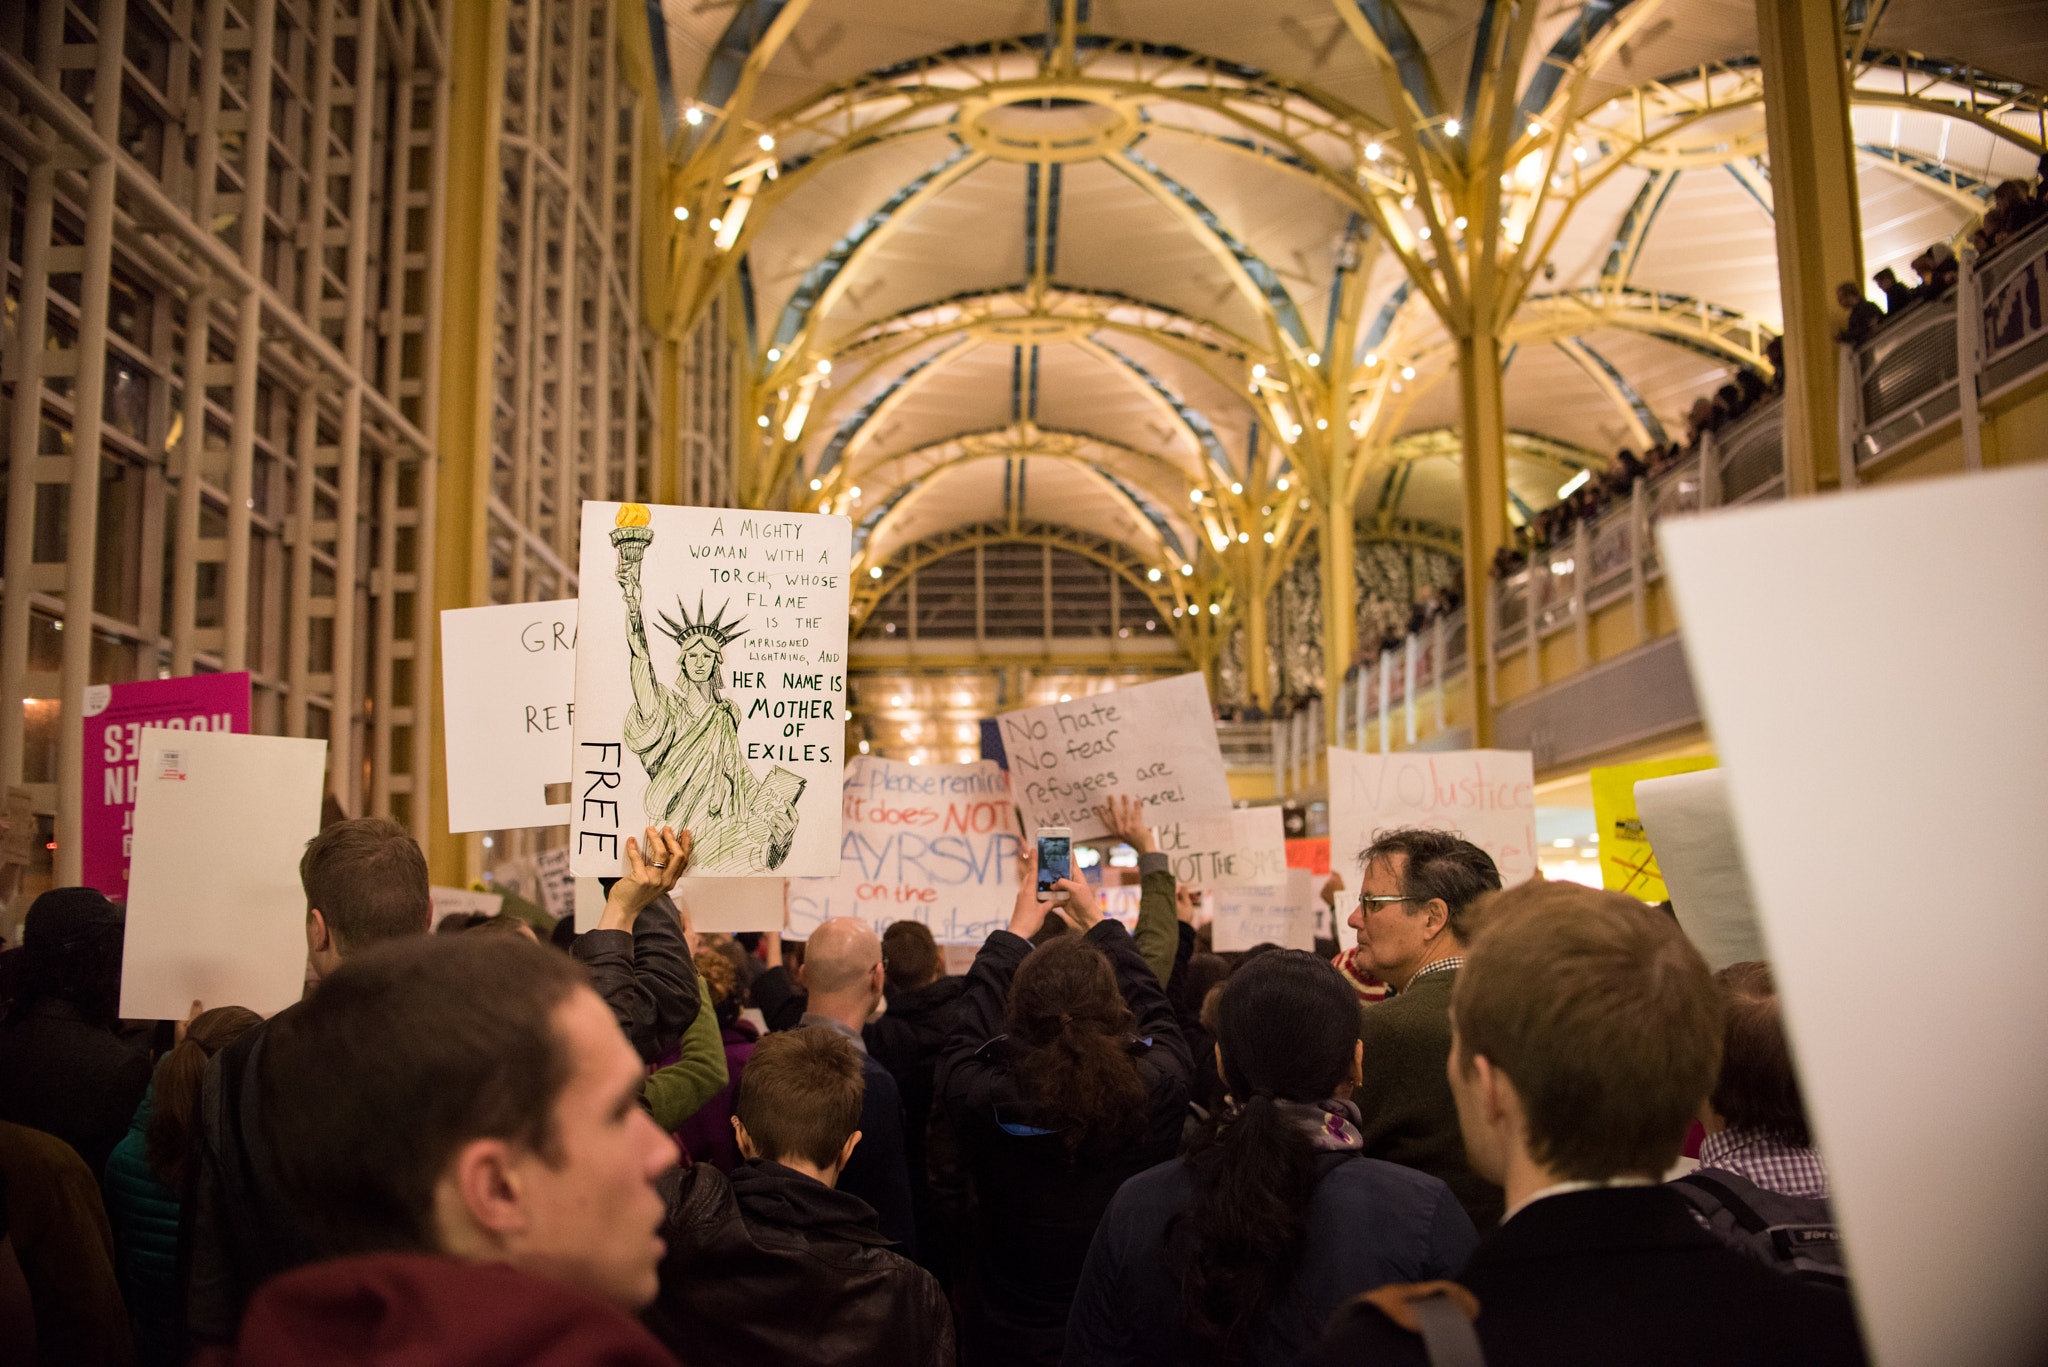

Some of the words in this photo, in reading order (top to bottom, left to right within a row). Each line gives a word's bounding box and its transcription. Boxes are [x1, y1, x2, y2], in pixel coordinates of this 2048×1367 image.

[711, 516, 724, 537] A
[740, 518, 803, 540] MIGHTY
[689, 545, 747, 560] WOMAN
[765, 548, 804, 562] WITH
[819, 550, 828, 564] A
[710, 568, 772, 590] TORCH,
[785, 574, 838, 589] WHOSE
[747, 592, 808, 609] FLAME
[766, 617, 778, 628] IS
[795, 617, 822, 629] THE
[744, 638, 809, 648] IMPRISONED
[749, 651, 810, 666] LIGHTNING,
[818, 650, 840, 663] AND
[733, 671, 766, 689] HER
[783, 672, 823, 690] NAME
[831, 676, 842, 692] IS
[748, 698, 834, 720] MOTHER
[783, 723, 805, 737] OF
[1005, 714, 1047, 743] No
[1054, 704, 1121, 734] hate
[748, 743, 832, 762] EXILES.
[1015, 747, 1058, 775] No
[1066, 730, 1119, 760] fear
[871, 763, 936, 800] please
[1025, 771, 1119, 804] refugees
[1136, 762, 1173, 781] are
[1420, 758, 1533, 812] Justice
[579, 742, 621, 860] FREE
[869, 799, 939, 826] does
[943, 801, 1010, 834] NOT
[1208, 851, 1236, 880] THE
[856, 882, 888, 901] on
[894, 884, 938, 904] the
